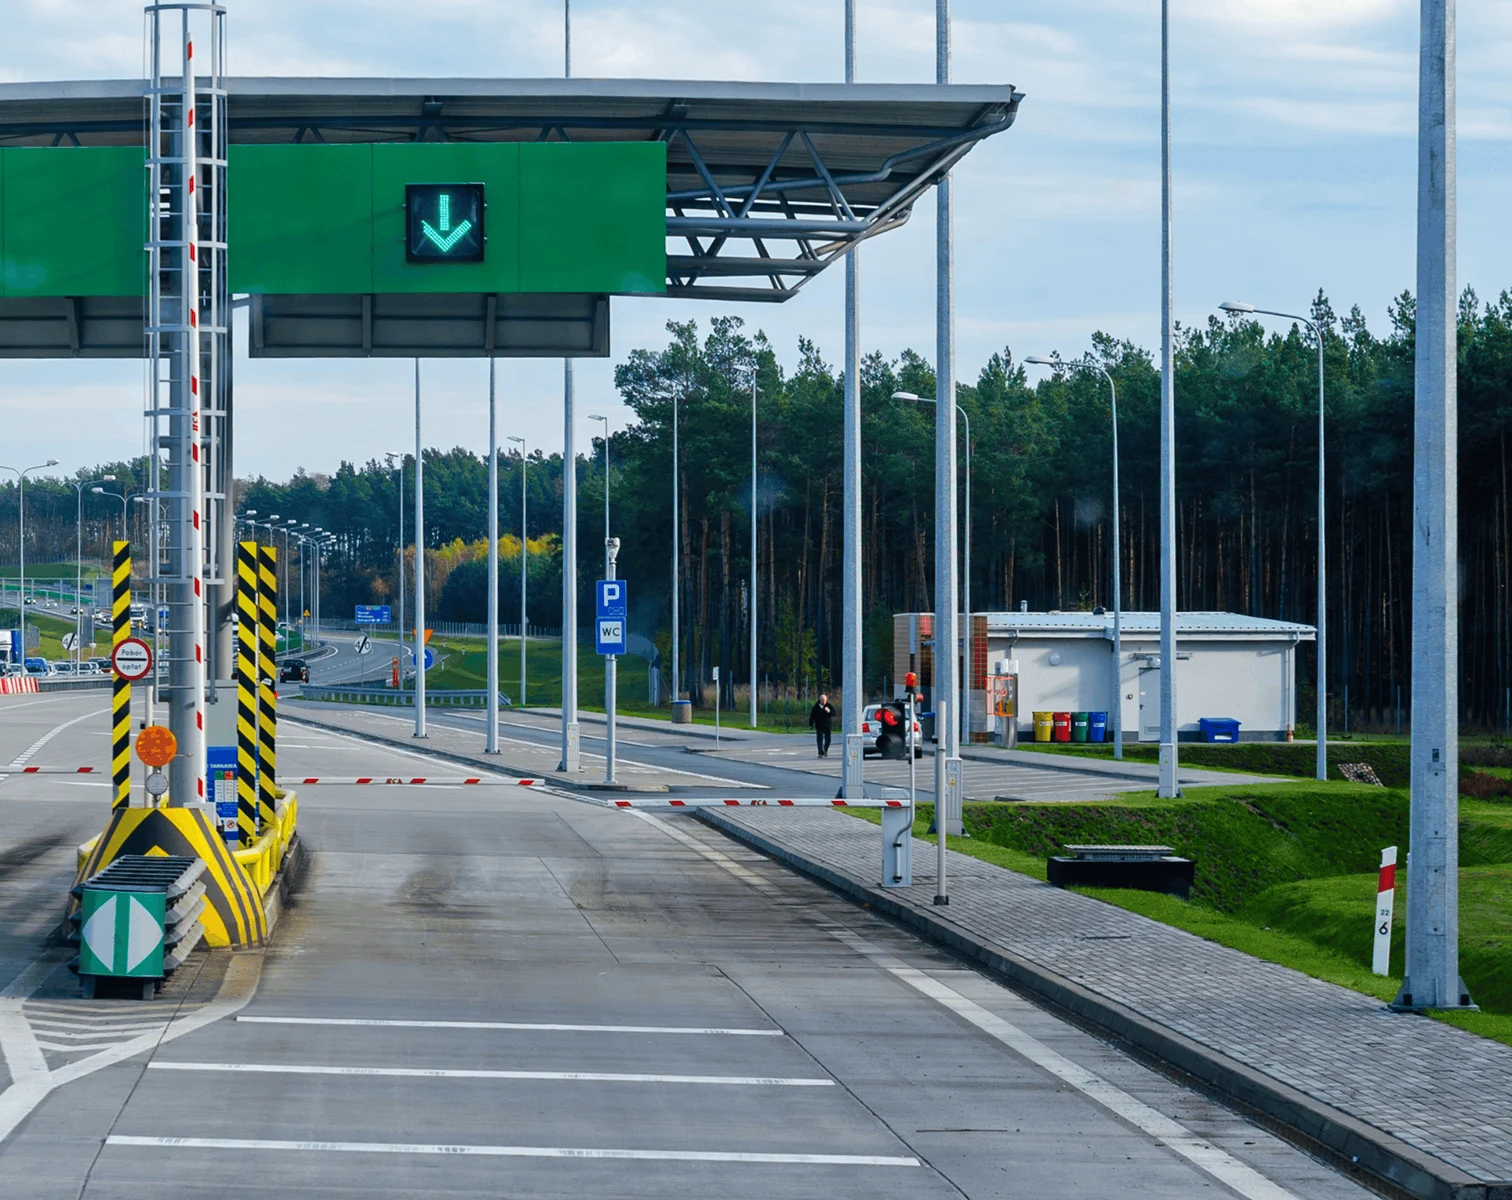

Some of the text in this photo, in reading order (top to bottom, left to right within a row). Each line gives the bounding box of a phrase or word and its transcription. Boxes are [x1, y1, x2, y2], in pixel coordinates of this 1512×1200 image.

[603, 584, 620, 607] P
[602, 627, 620, 637] WC
[355, 641, 371, 650] 40
[1378, 921, 1388, 936] 6
